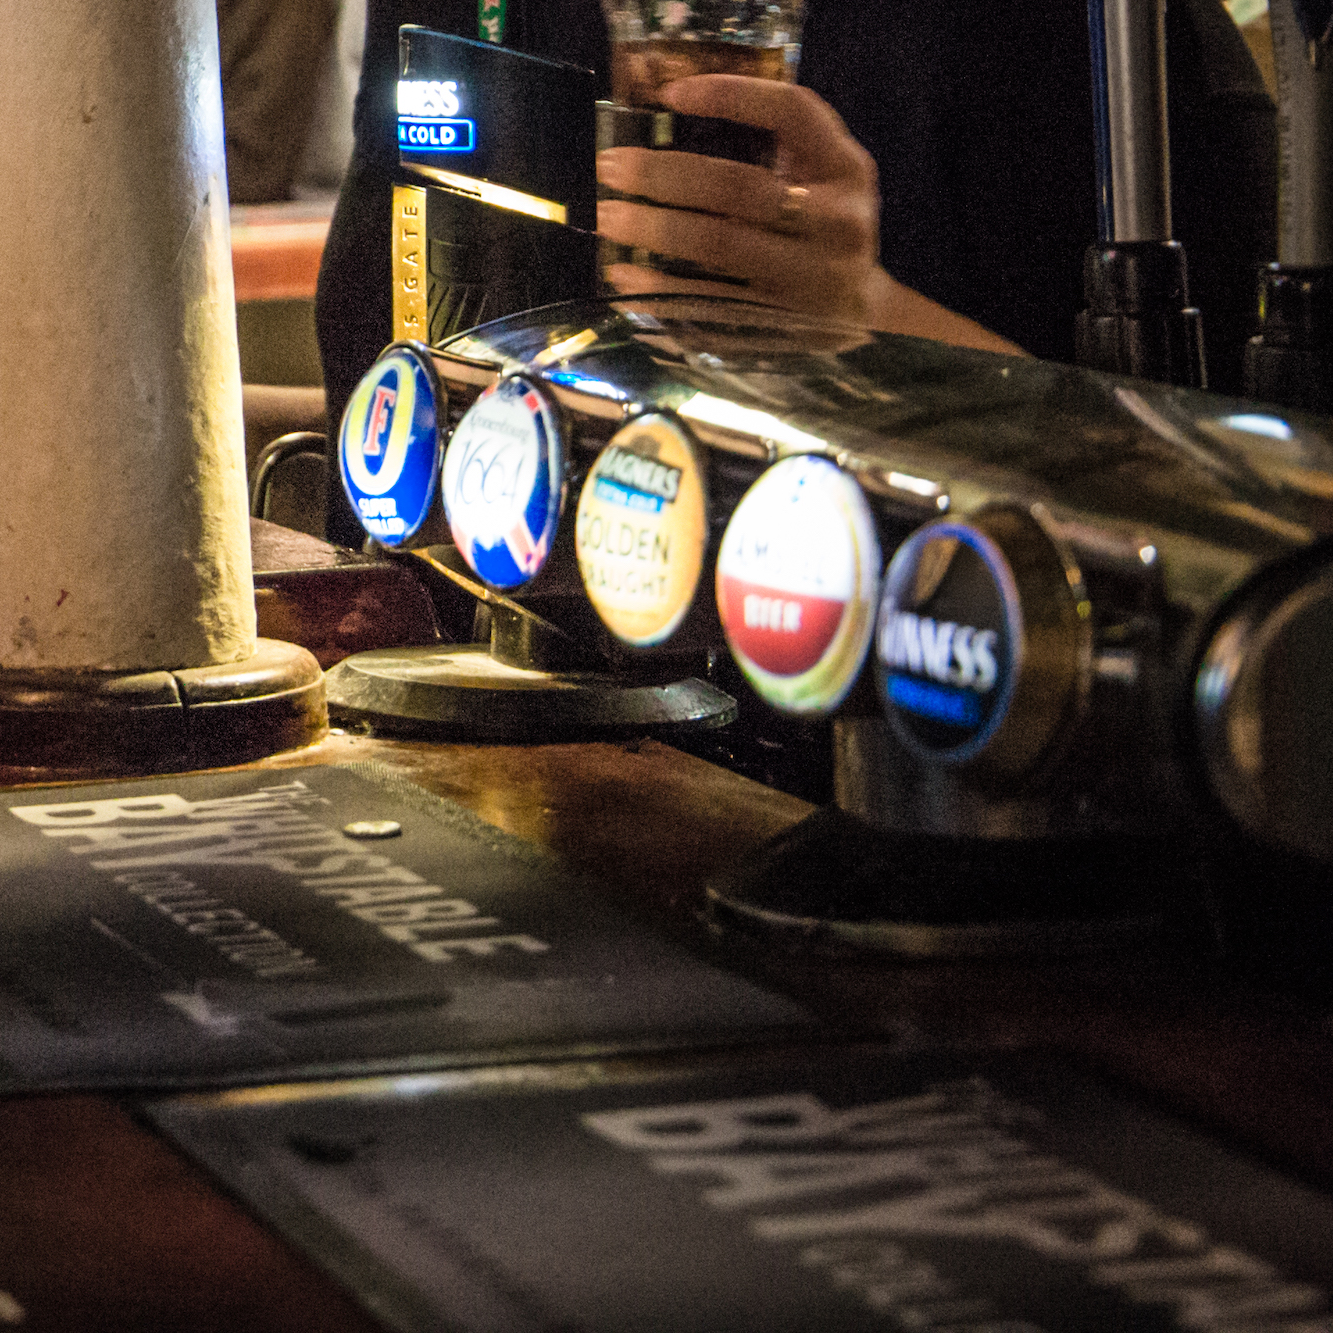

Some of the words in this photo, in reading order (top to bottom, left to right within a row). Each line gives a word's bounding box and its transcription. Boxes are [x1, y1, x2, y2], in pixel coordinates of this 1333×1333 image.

[408, 125, 456, 146] COLD
[363, 386, 396, 456] F
[453, 437, 527, 507] 1664
[8, 793, 295, 871] BAY
